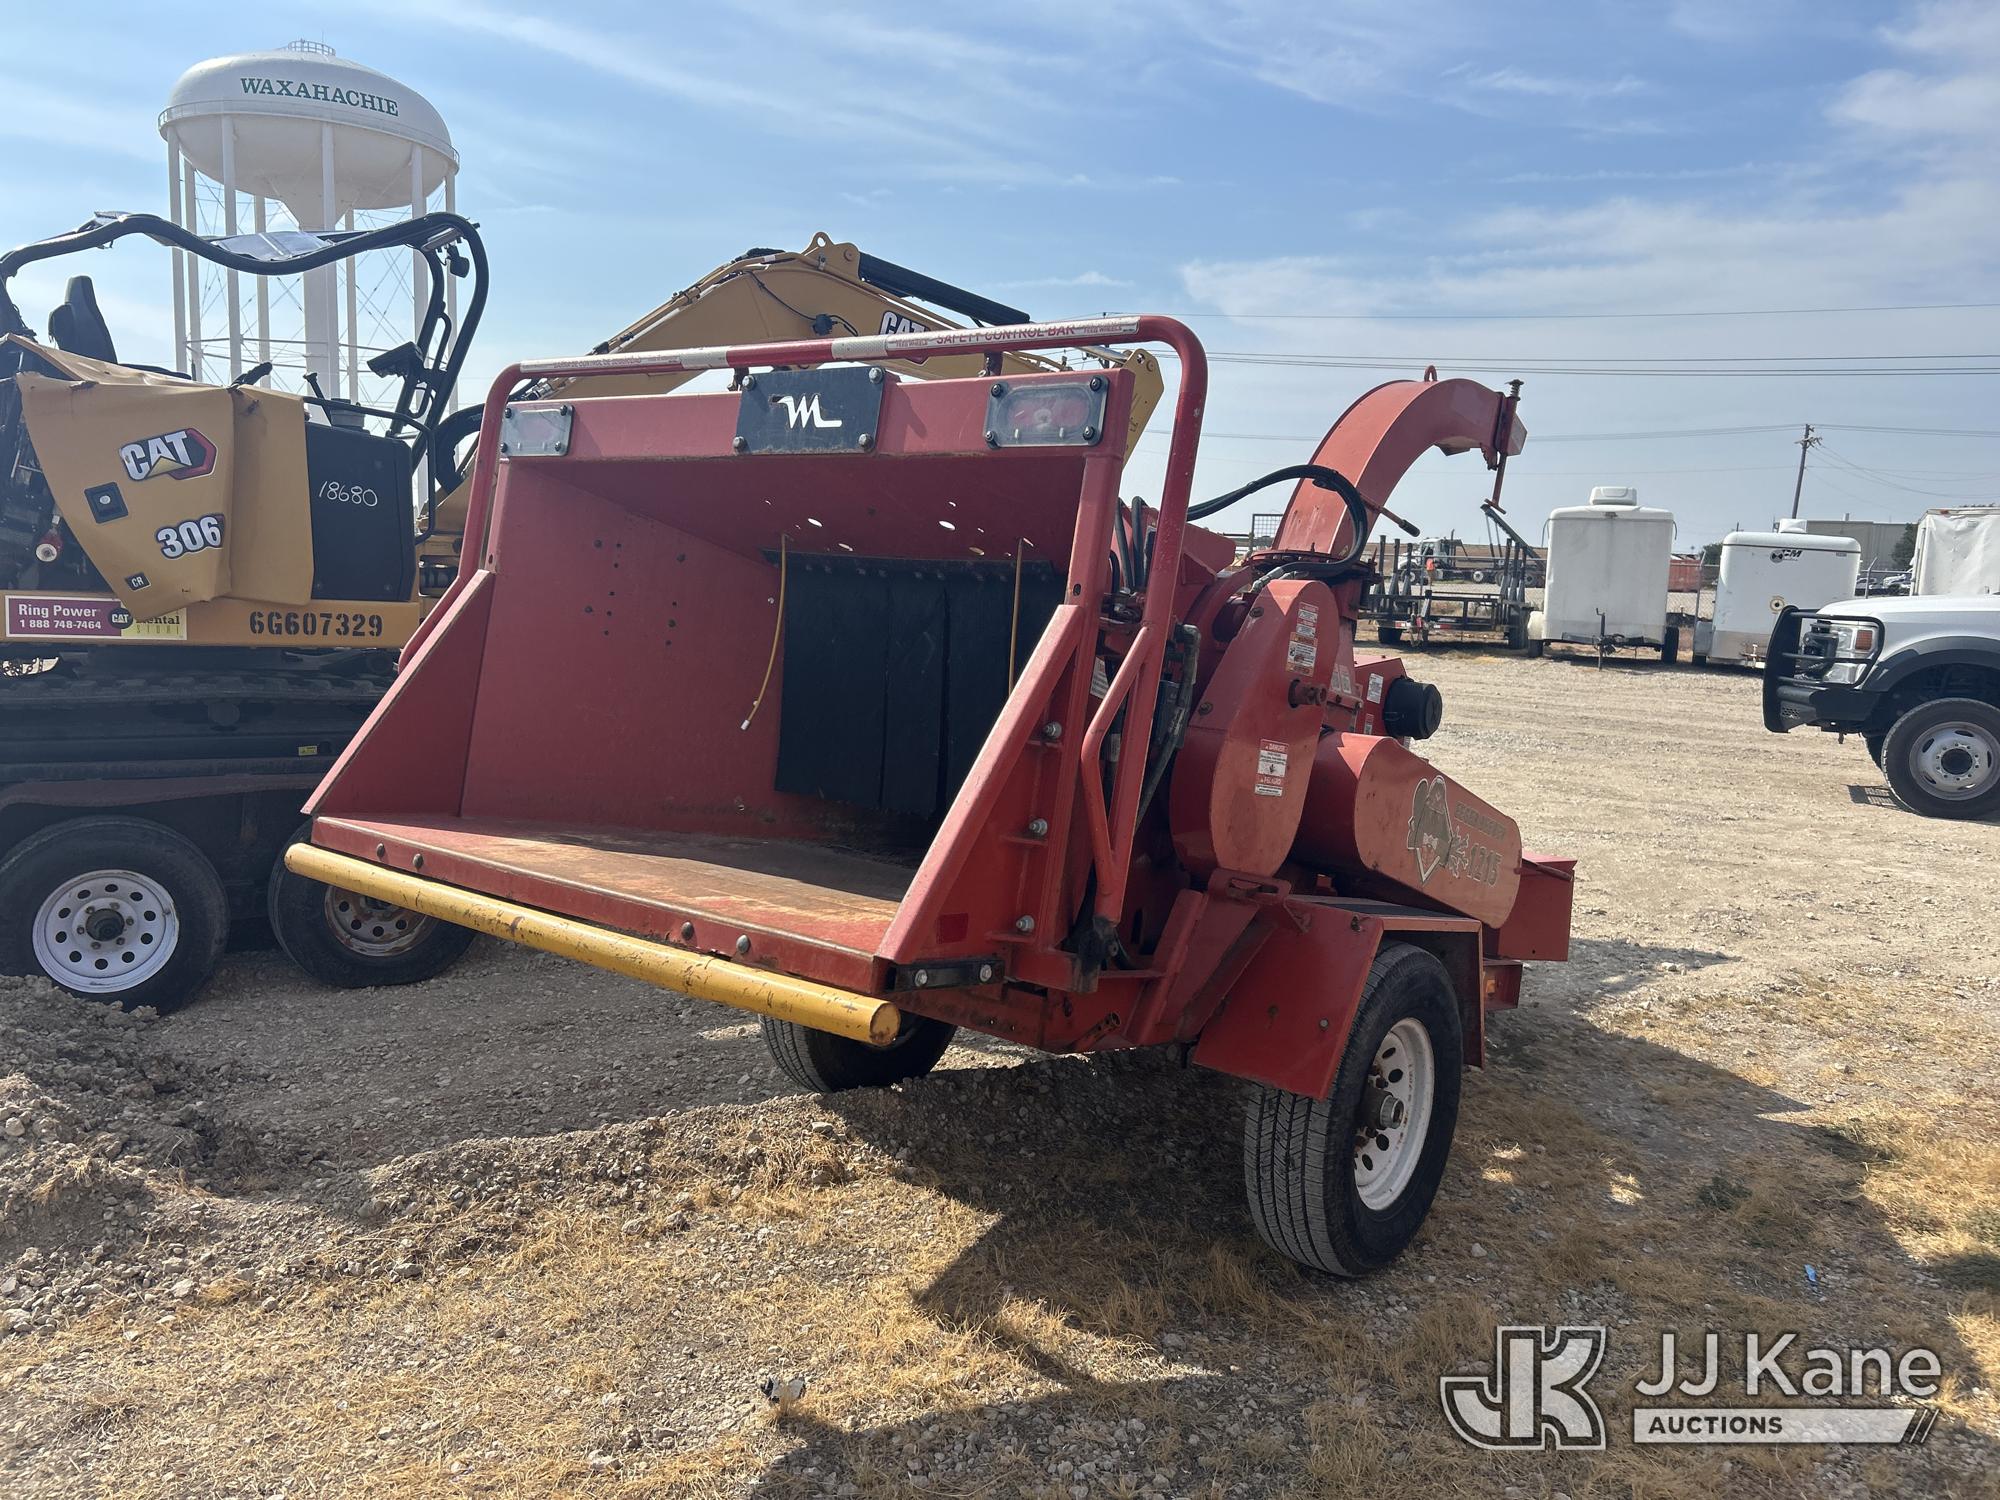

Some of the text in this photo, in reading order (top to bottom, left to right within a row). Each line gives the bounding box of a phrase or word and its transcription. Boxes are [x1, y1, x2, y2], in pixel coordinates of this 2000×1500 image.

[240, 78, 399, 117] WAXAHACHIE
[985, 327, 1044, 342] CONTROL
[121, 430, 193, 480] CAT
[318, 480, 378, 507] 18680
[157, 516, 222, 558] 306
[131, 576, 144, 588] CR
[18, 603, 98, 619] Ring Power
[111, 613, 130, 624] CAT
[19, 619, 101, 630] 1 888 748-7464
[135, 615, 180, 625] ental
[249, 611, 383, 637] 6G607329
